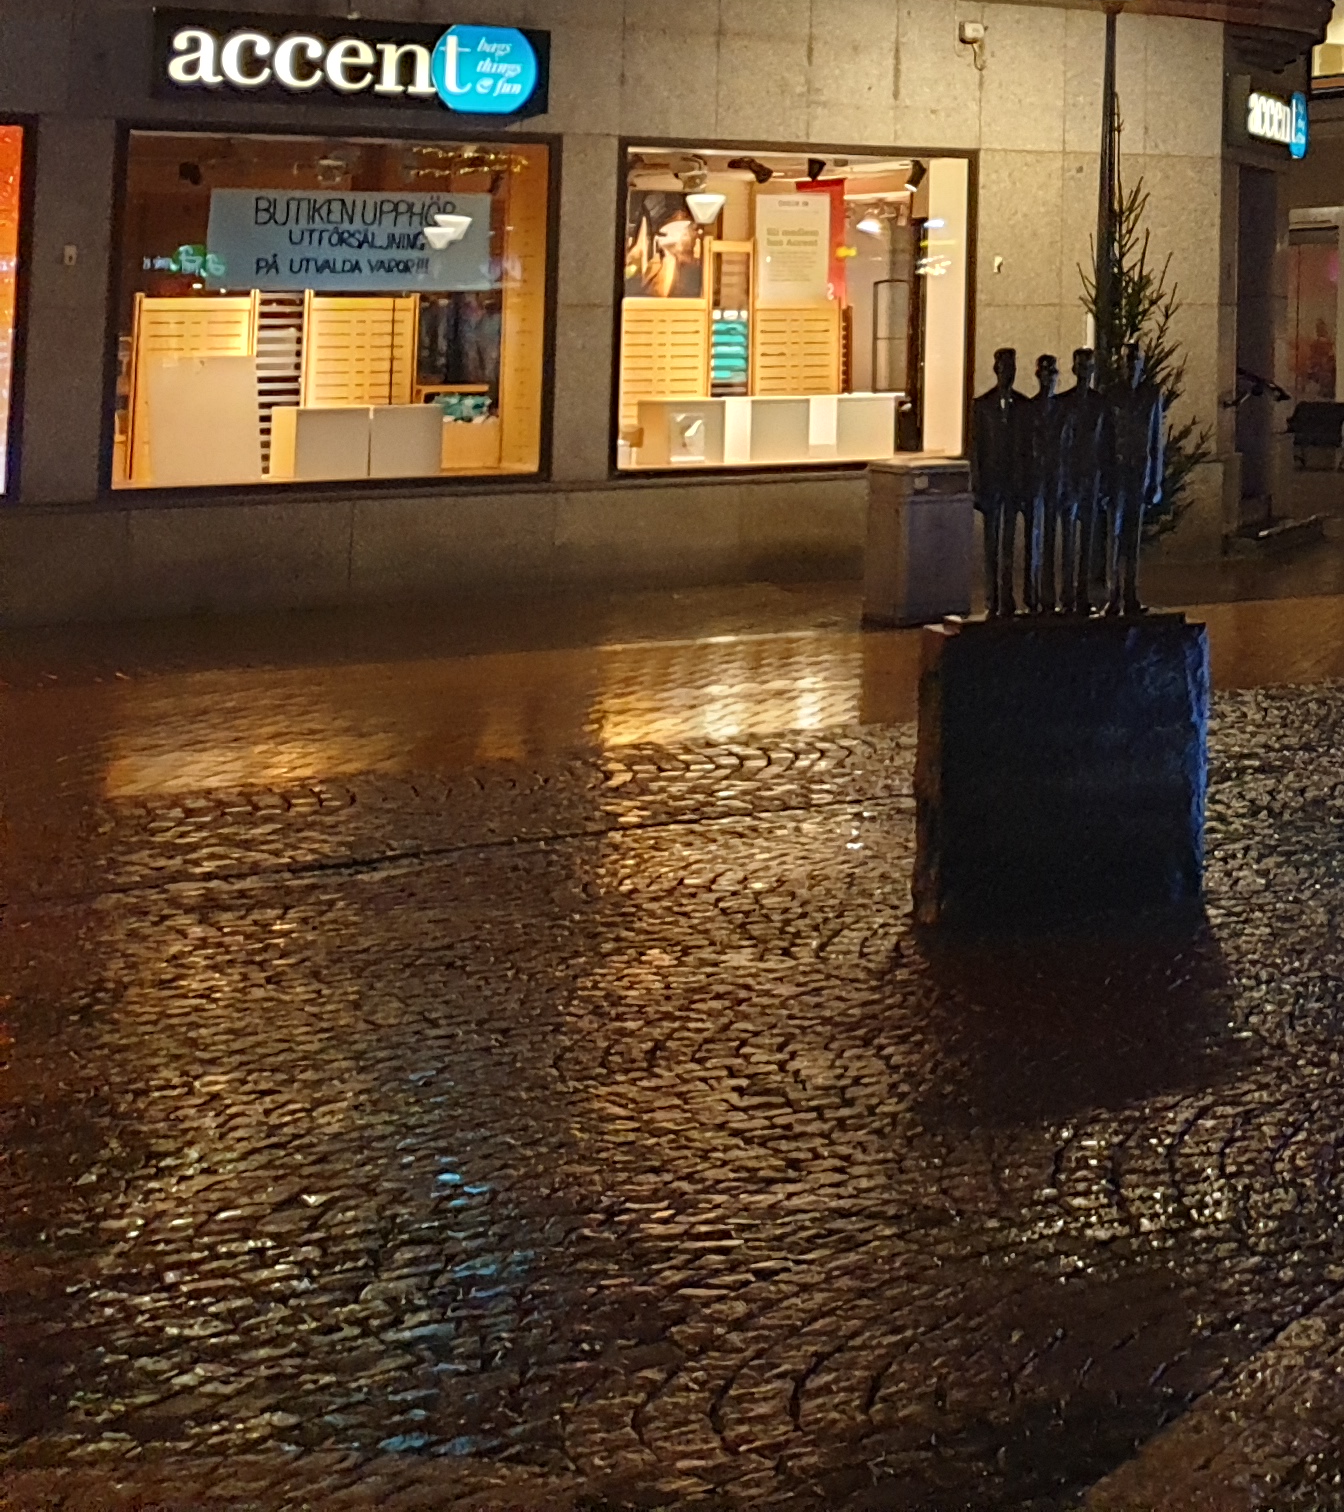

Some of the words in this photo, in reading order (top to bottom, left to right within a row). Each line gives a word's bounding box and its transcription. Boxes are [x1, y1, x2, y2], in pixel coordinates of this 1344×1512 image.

[168, 29, 472, 96] accent
[1247, 92, 1296, 143] accent
[254, 196, 355, 226] BUTIKEN
[288, 226, 426, 251] UTFÖRSÄLJNING
[255, 253, 279, 275] PÅ
[289, 257, 362, 275] UTVALDA
